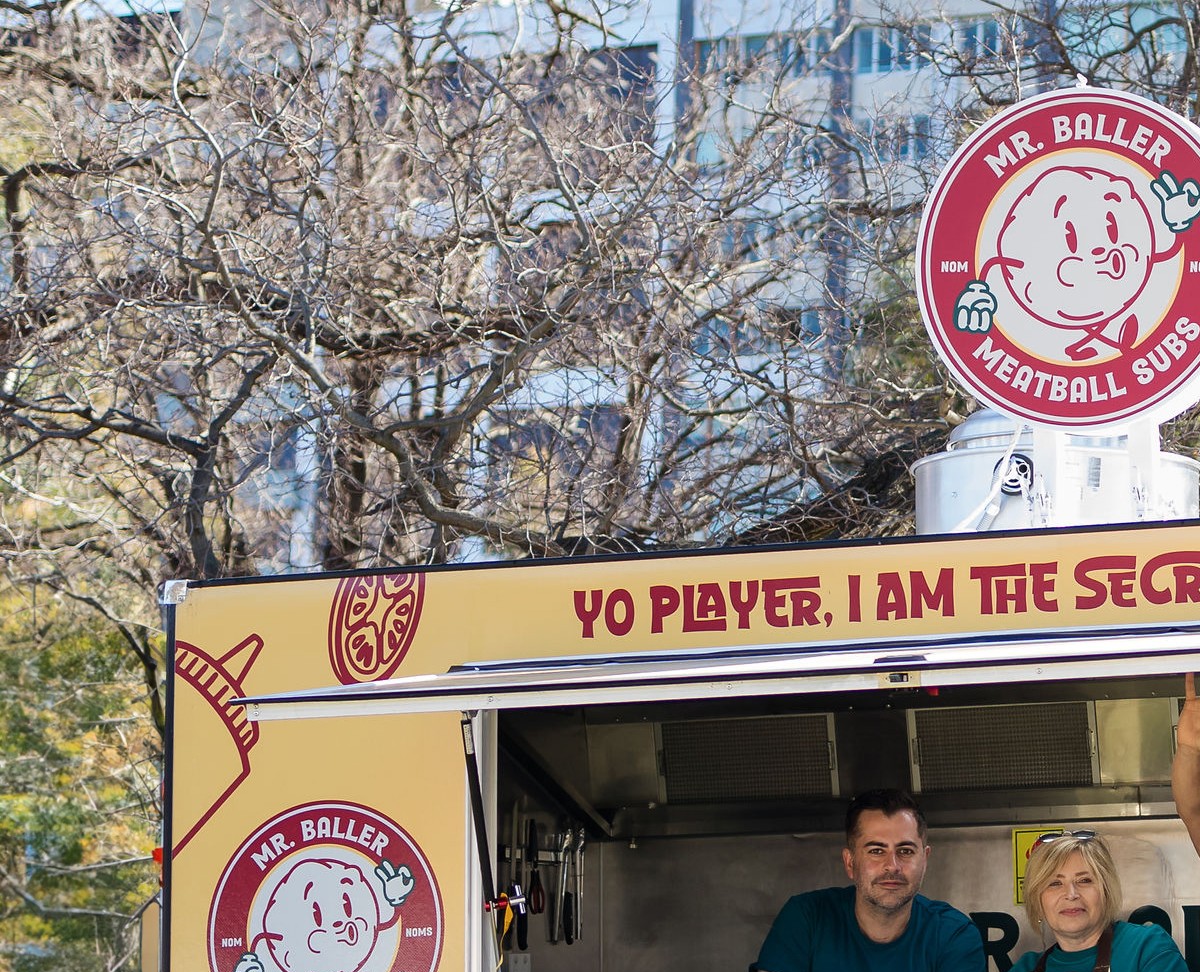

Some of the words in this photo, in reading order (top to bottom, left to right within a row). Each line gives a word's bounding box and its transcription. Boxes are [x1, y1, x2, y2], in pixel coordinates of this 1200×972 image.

[984, 131, 1044, 178] MR.
[1052, 113, 1172, 168] BALLER
[941, 261, 968, 273] NOM
[972, 336, 1127, 403] MEATBALL
[1132, 316, 1200, 385] SUBS
[573, 588, 635, 639] YO
[649, 576, 833, 634] PLAYER,
[848, 575, 860, 623] I
[876, 568, 955, 622] AM
[970, 561, 1058, 616] THE
[251, 832, 296, 871] MR.
[300, 816, 390, 857] BALLER
[221, 937, 242, 948] NOM
[405, 926, 433, 938] NOMS
